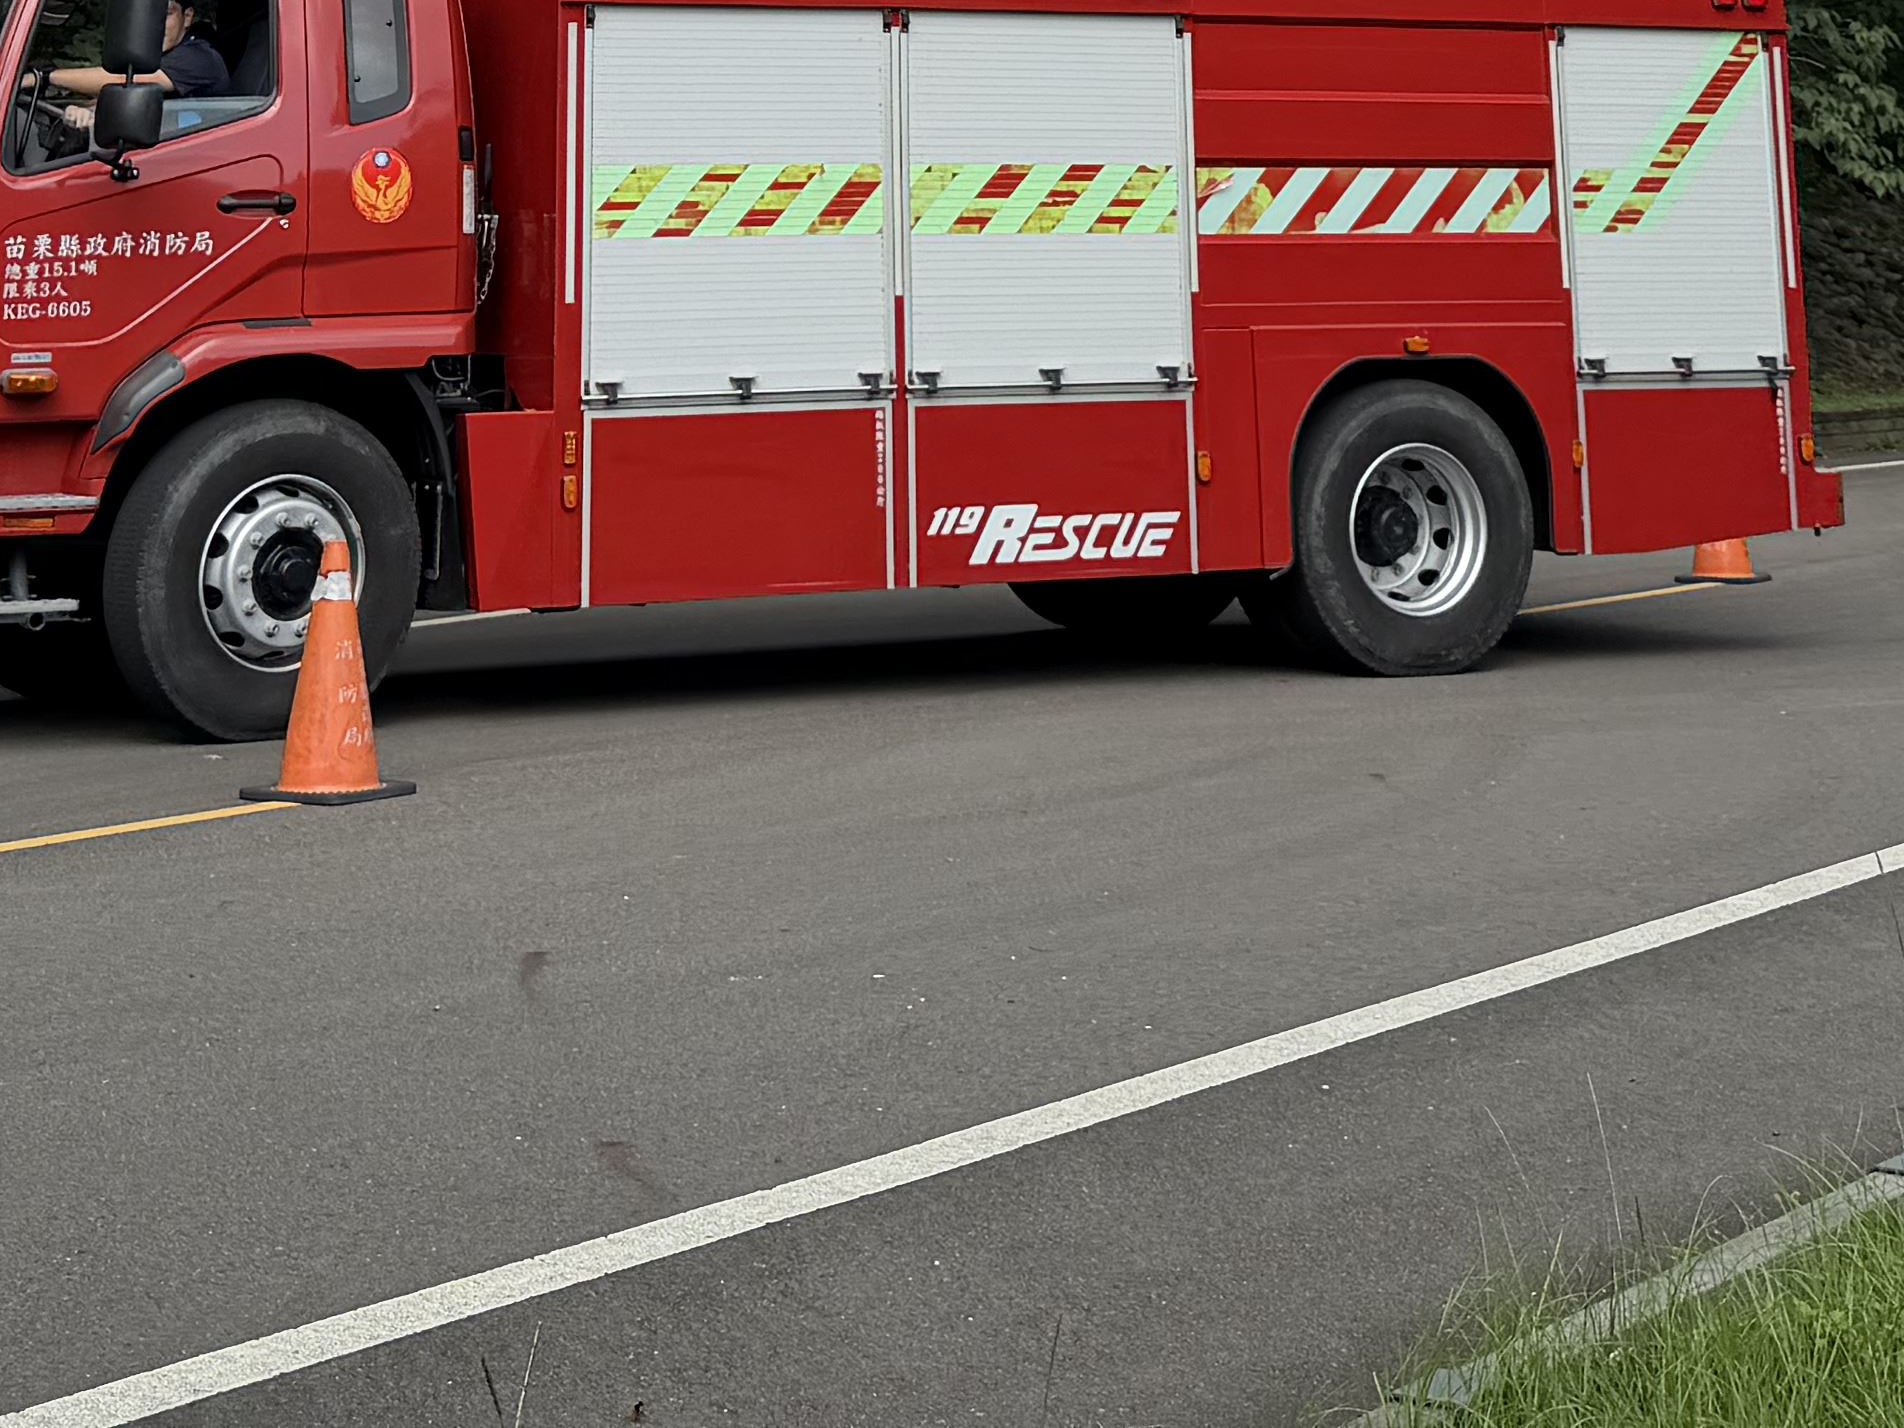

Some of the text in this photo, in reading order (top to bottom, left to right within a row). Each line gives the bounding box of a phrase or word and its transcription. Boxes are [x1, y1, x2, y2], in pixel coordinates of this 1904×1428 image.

[4, 230, 215, 260] 苗栗縣政府消防局
